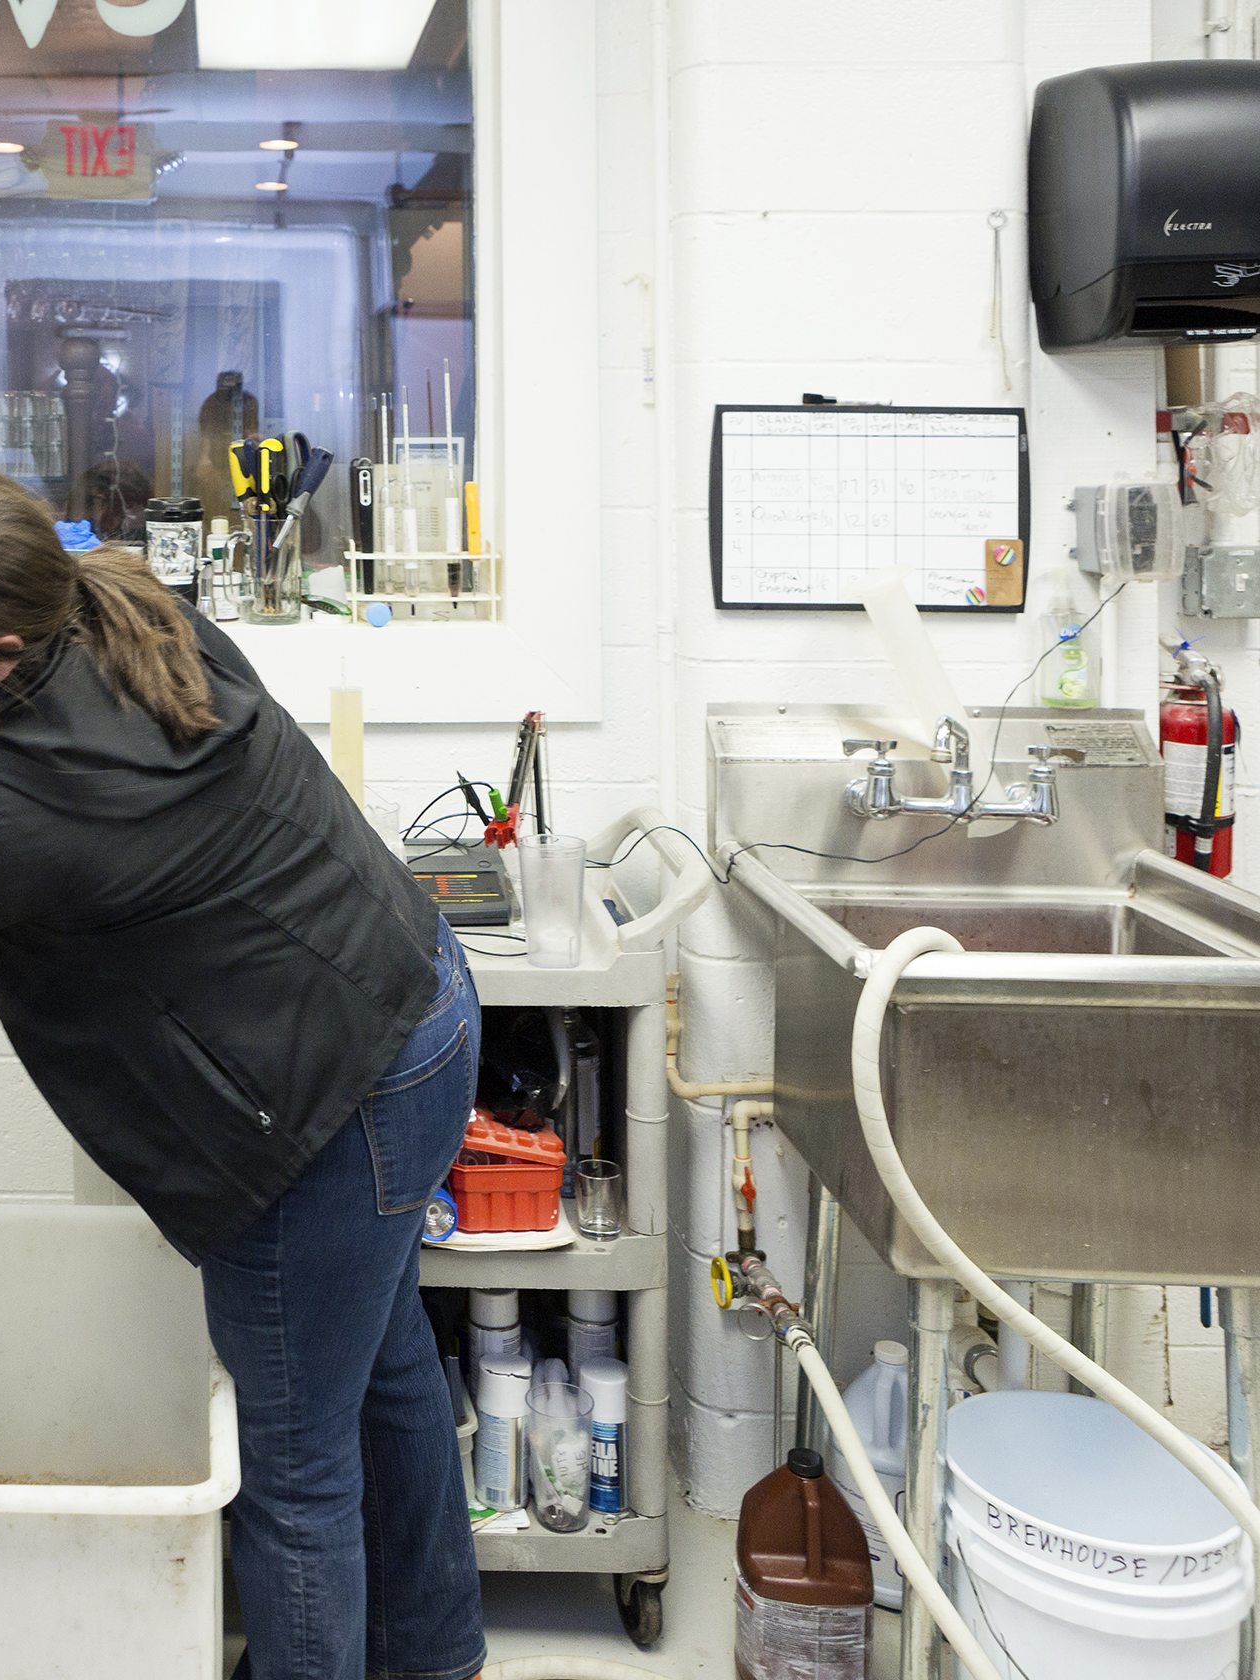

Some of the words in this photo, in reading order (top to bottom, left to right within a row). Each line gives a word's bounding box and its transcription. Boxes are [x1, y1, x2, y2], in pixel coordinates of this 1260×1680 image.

[1167, 222, 1213, 231] ELECTRA
[592, 1442, 618, 1460] EILA
[592, 1458, 619, 1477] INE
